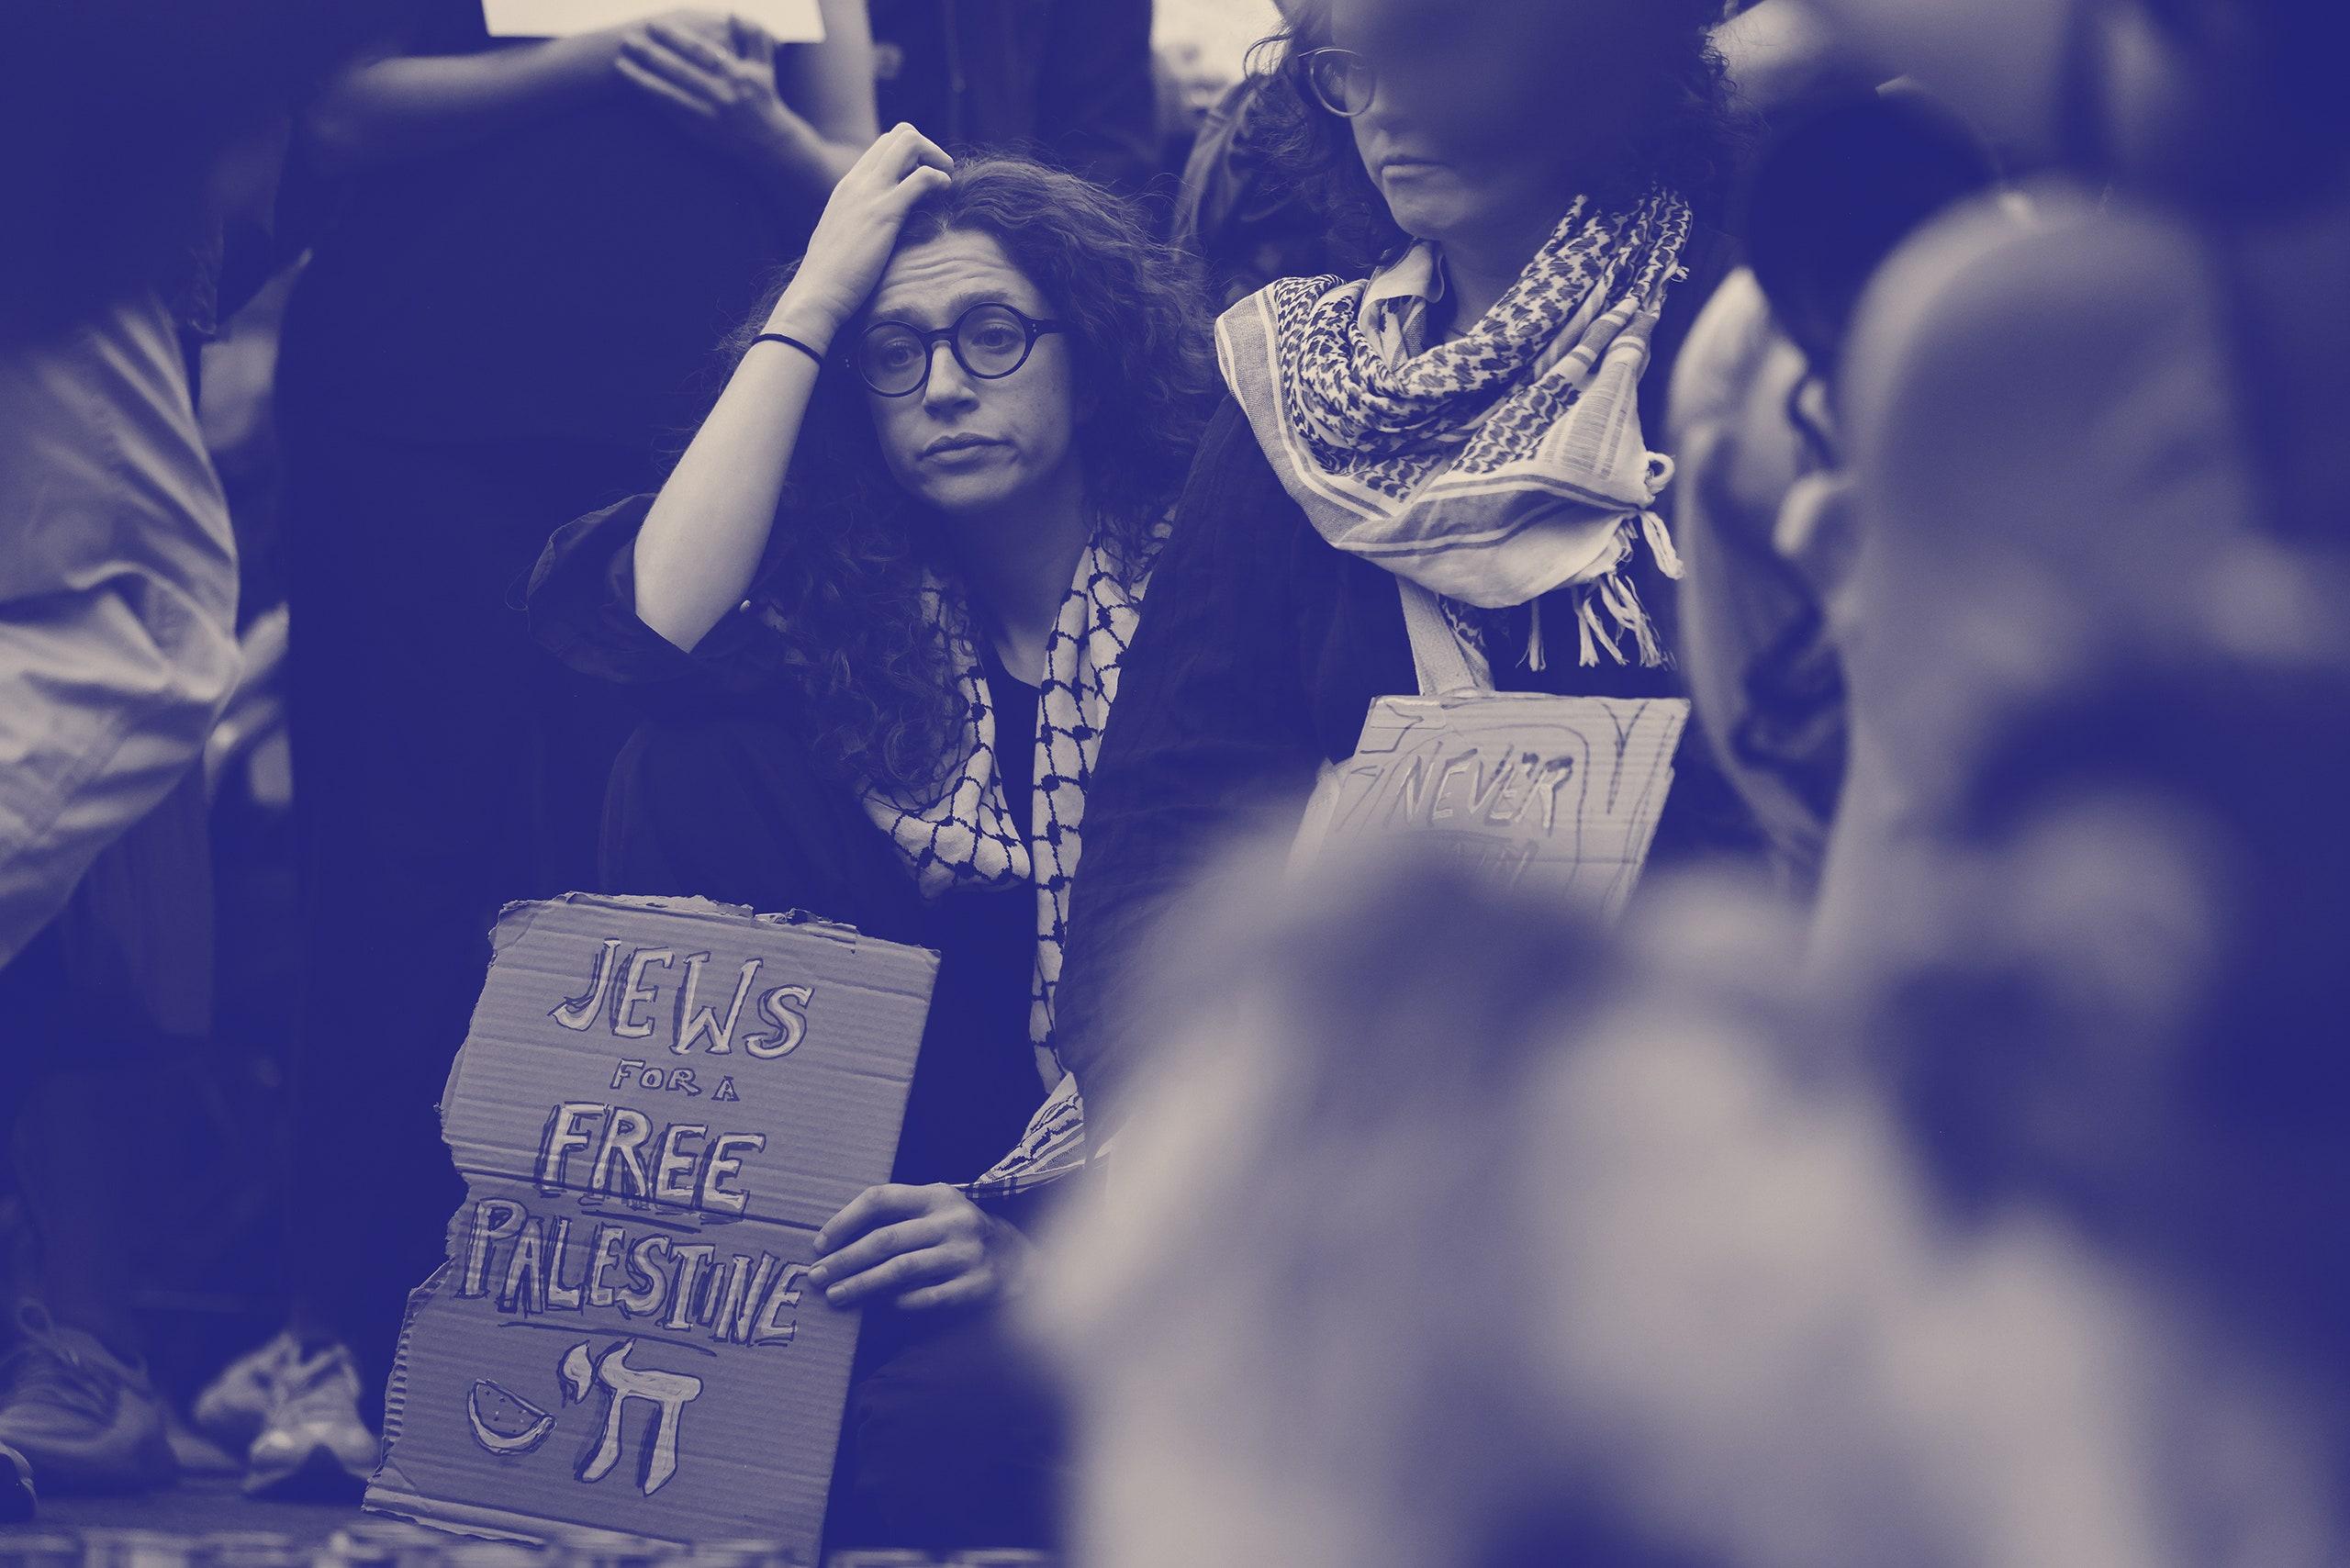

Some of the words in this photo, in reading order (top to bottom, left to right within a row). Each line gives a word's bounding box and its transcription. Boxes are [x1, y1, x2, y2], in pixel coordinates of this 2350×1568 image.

[1397, 744, 1573, 836] NEVER
[549, 937, 815, 1059] JEWS
[610, 1058, 701, 1096] FOR
[711, 1076, 740, 1102] A
[534, 1102, 766, 1215] FREE
[456, 1198, 814, 1345] PALESTINE
[556, 1338, 703, 1496] חי
